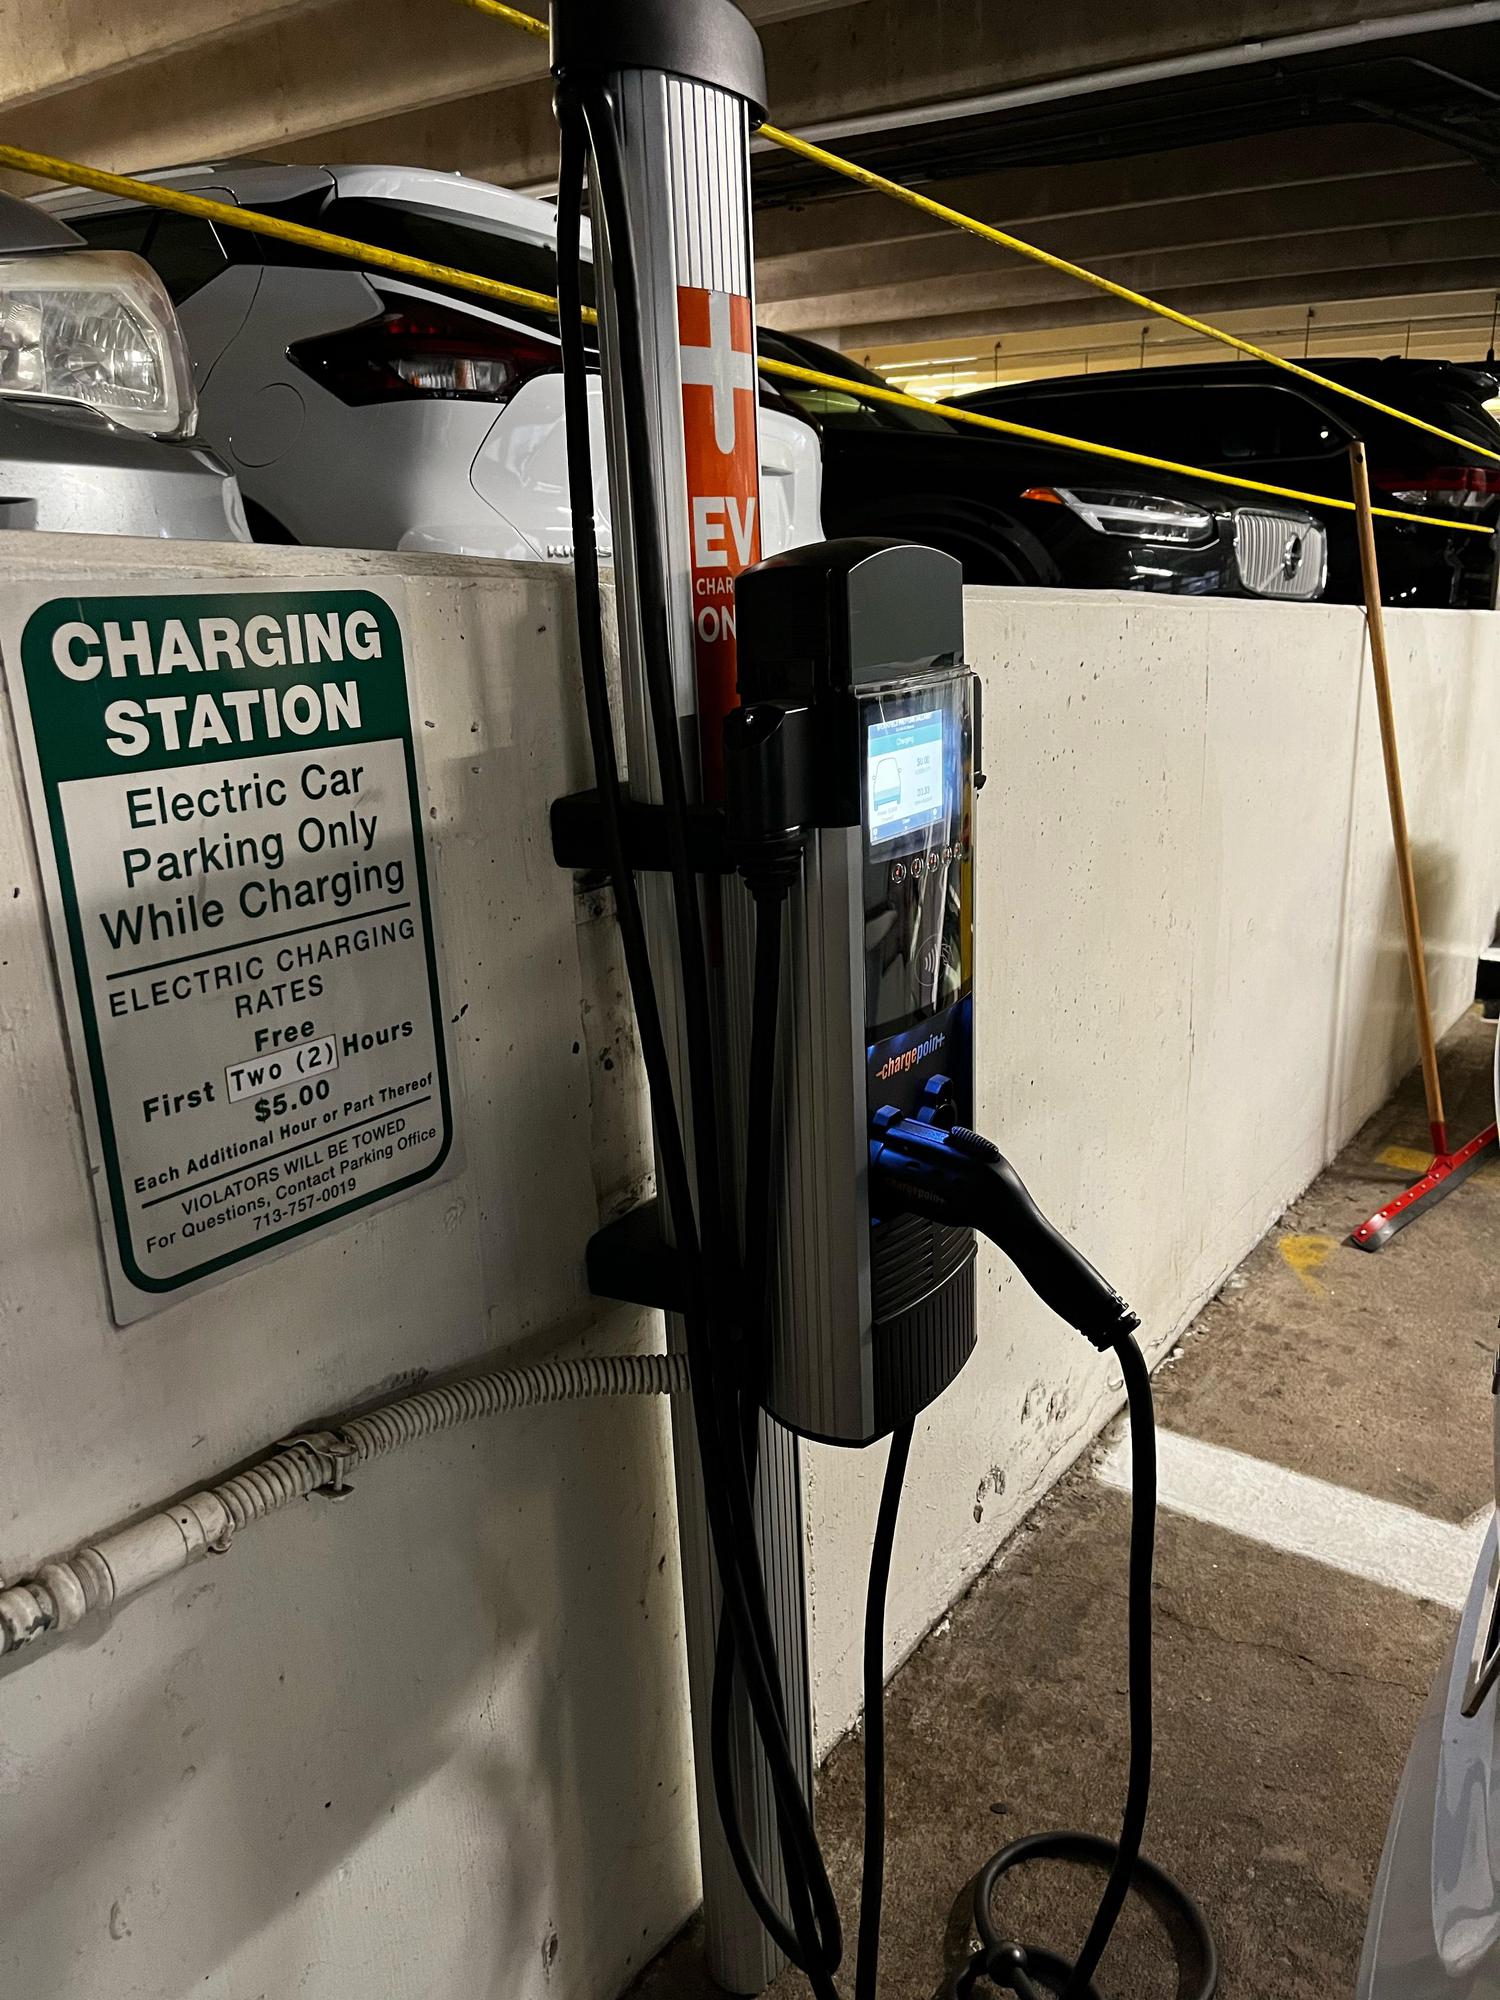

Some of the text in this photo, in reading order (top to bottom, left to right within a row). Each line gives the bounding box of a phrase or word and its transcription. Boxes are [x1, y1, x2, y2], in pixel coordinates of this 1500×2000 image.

[693, 496, 756, 568] EV
[696, 576, 734, 596] CHAR
[52, 610, 383, 681] CHARGING
[697, 604, 737, 643] ON
[106, 681, 362, 756] STATION
[126, 763, 364, 829] Electric Car
[123, 810, 378, 888] Parking Only
[100, 860, 404, 949] While Charging
[108, 918, 415, 1017] ELECTRIC CHARGING
[235, 974, 324, 1019] RATES
[142, 1019, 414, 1123] First Two (2) Hours
[254, 1020, 315, 1052] Free
[134, 1072, 433, 1194] Each Additional Hour or Part Thereof
[254, 1079, 330, 1123] $5.00
[146, 1127, 436, 1253] For Questions, Contact Parking Office
[181, 1118, 406, 1216] VIOLATORS WILL BE TOWED
[253, 1178, 357, 1231] 713-757-0019
